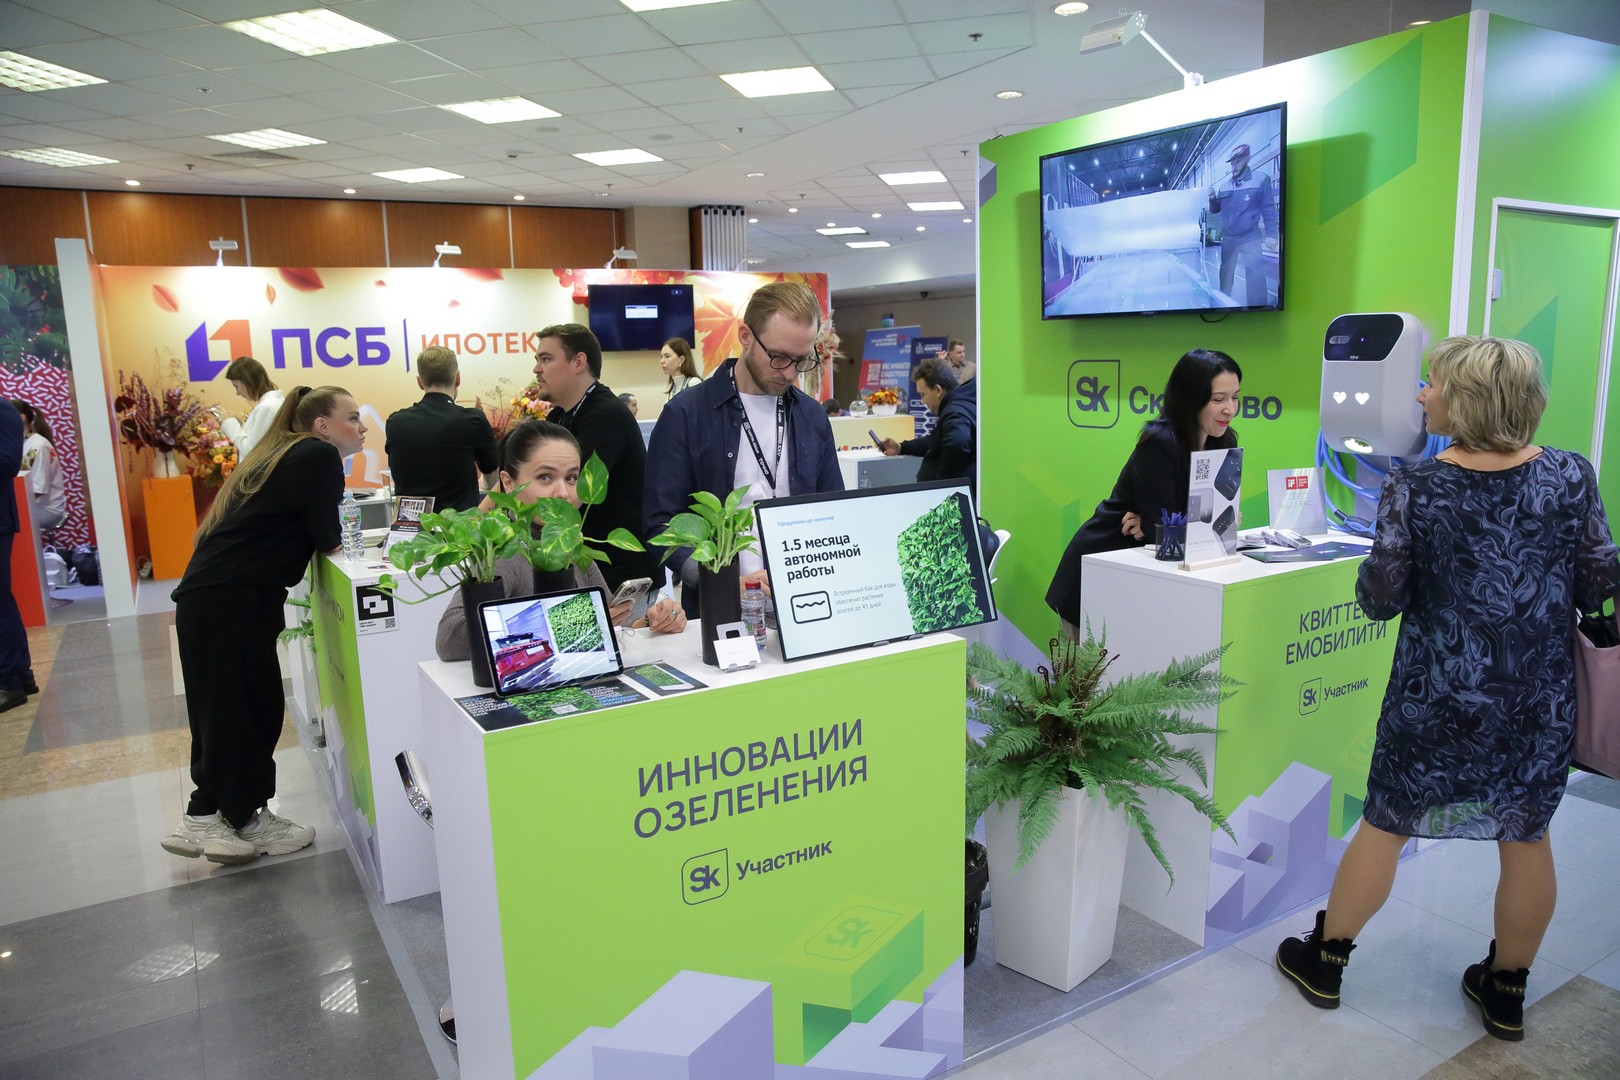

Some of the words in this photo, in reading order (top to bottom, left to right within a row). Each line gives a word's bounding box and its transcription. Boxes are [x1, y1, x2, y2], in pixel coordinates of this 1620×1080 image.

[271, 326, 391, 368] ПСБ
[421, 332, 538, 356] ИПОТЕК
[1076, 376, 1110, 412] Sk
[1129, 386, 1282, 420] Скво
[782, 538, 802, 552] 1.5
[804, 534, 850, 549] месяца
[784, 544, 862, 566] автономной
[787, 566, 835, 584] работы
[834, 588, 864, 596] Встроенный
[835, 597, 860, 606] обеспечит
[862, 593, 884, 602] растения
[1299, 600, 1367, 634] КВИТТЕ
[1286, 620, 1386, 665] ЕМОБИЛИТИ
[1302, 688, 1317, 707] Sk
[1324, 678, 1368, 701] Участник
[638, 718, 862, 798] ИННОВАЦИИ
[634, 755, 868, 838] ОЗЕЛЕНЕНИЯ
[689, 864, 721, 893] Sk
[735, 840, 833, 881] Участник
